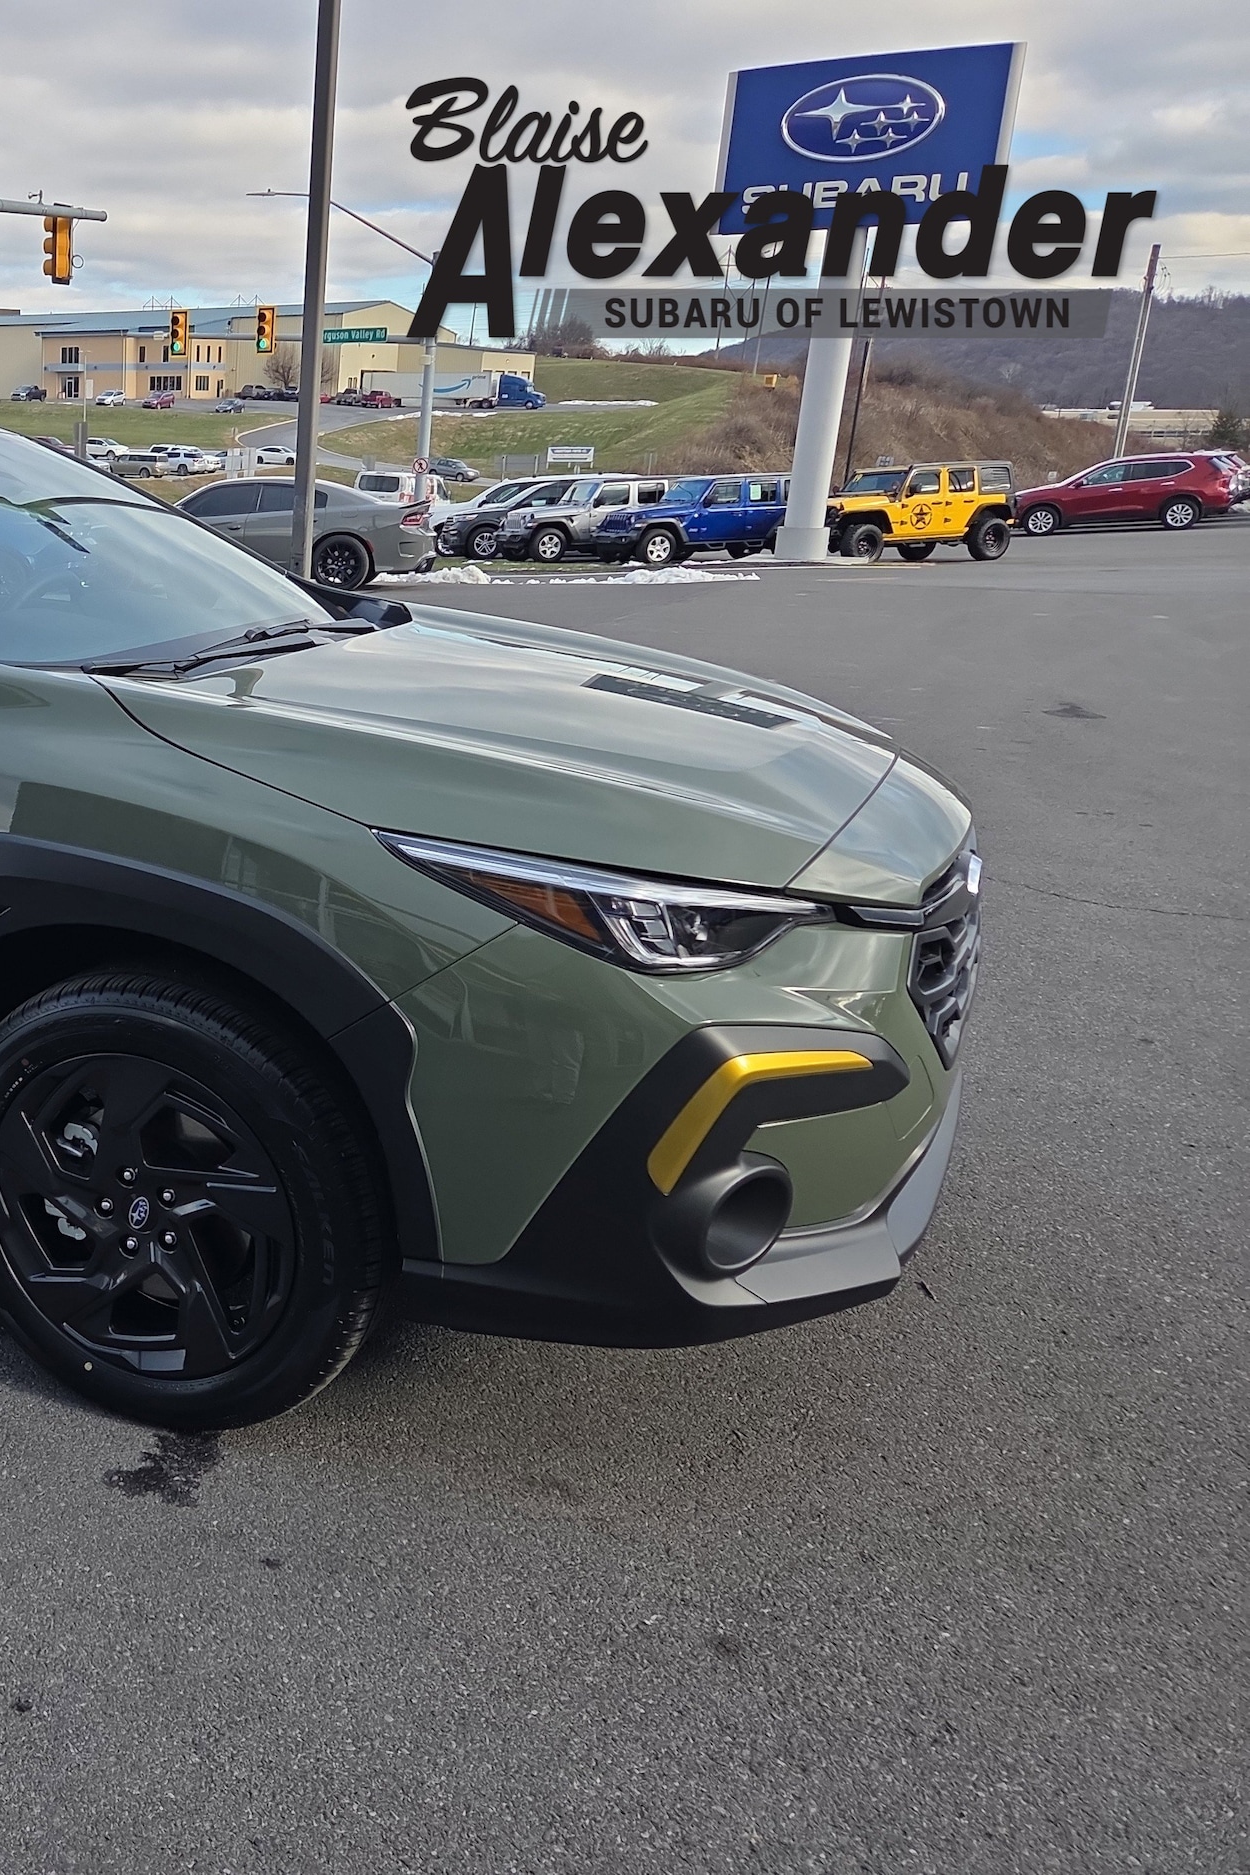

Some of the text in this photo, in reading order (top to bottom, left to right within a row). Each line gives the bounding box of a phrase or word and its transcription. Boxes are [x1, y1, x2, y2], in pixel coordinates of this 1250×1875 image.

[324, 328, 386, 342] rguson Valley Rd
